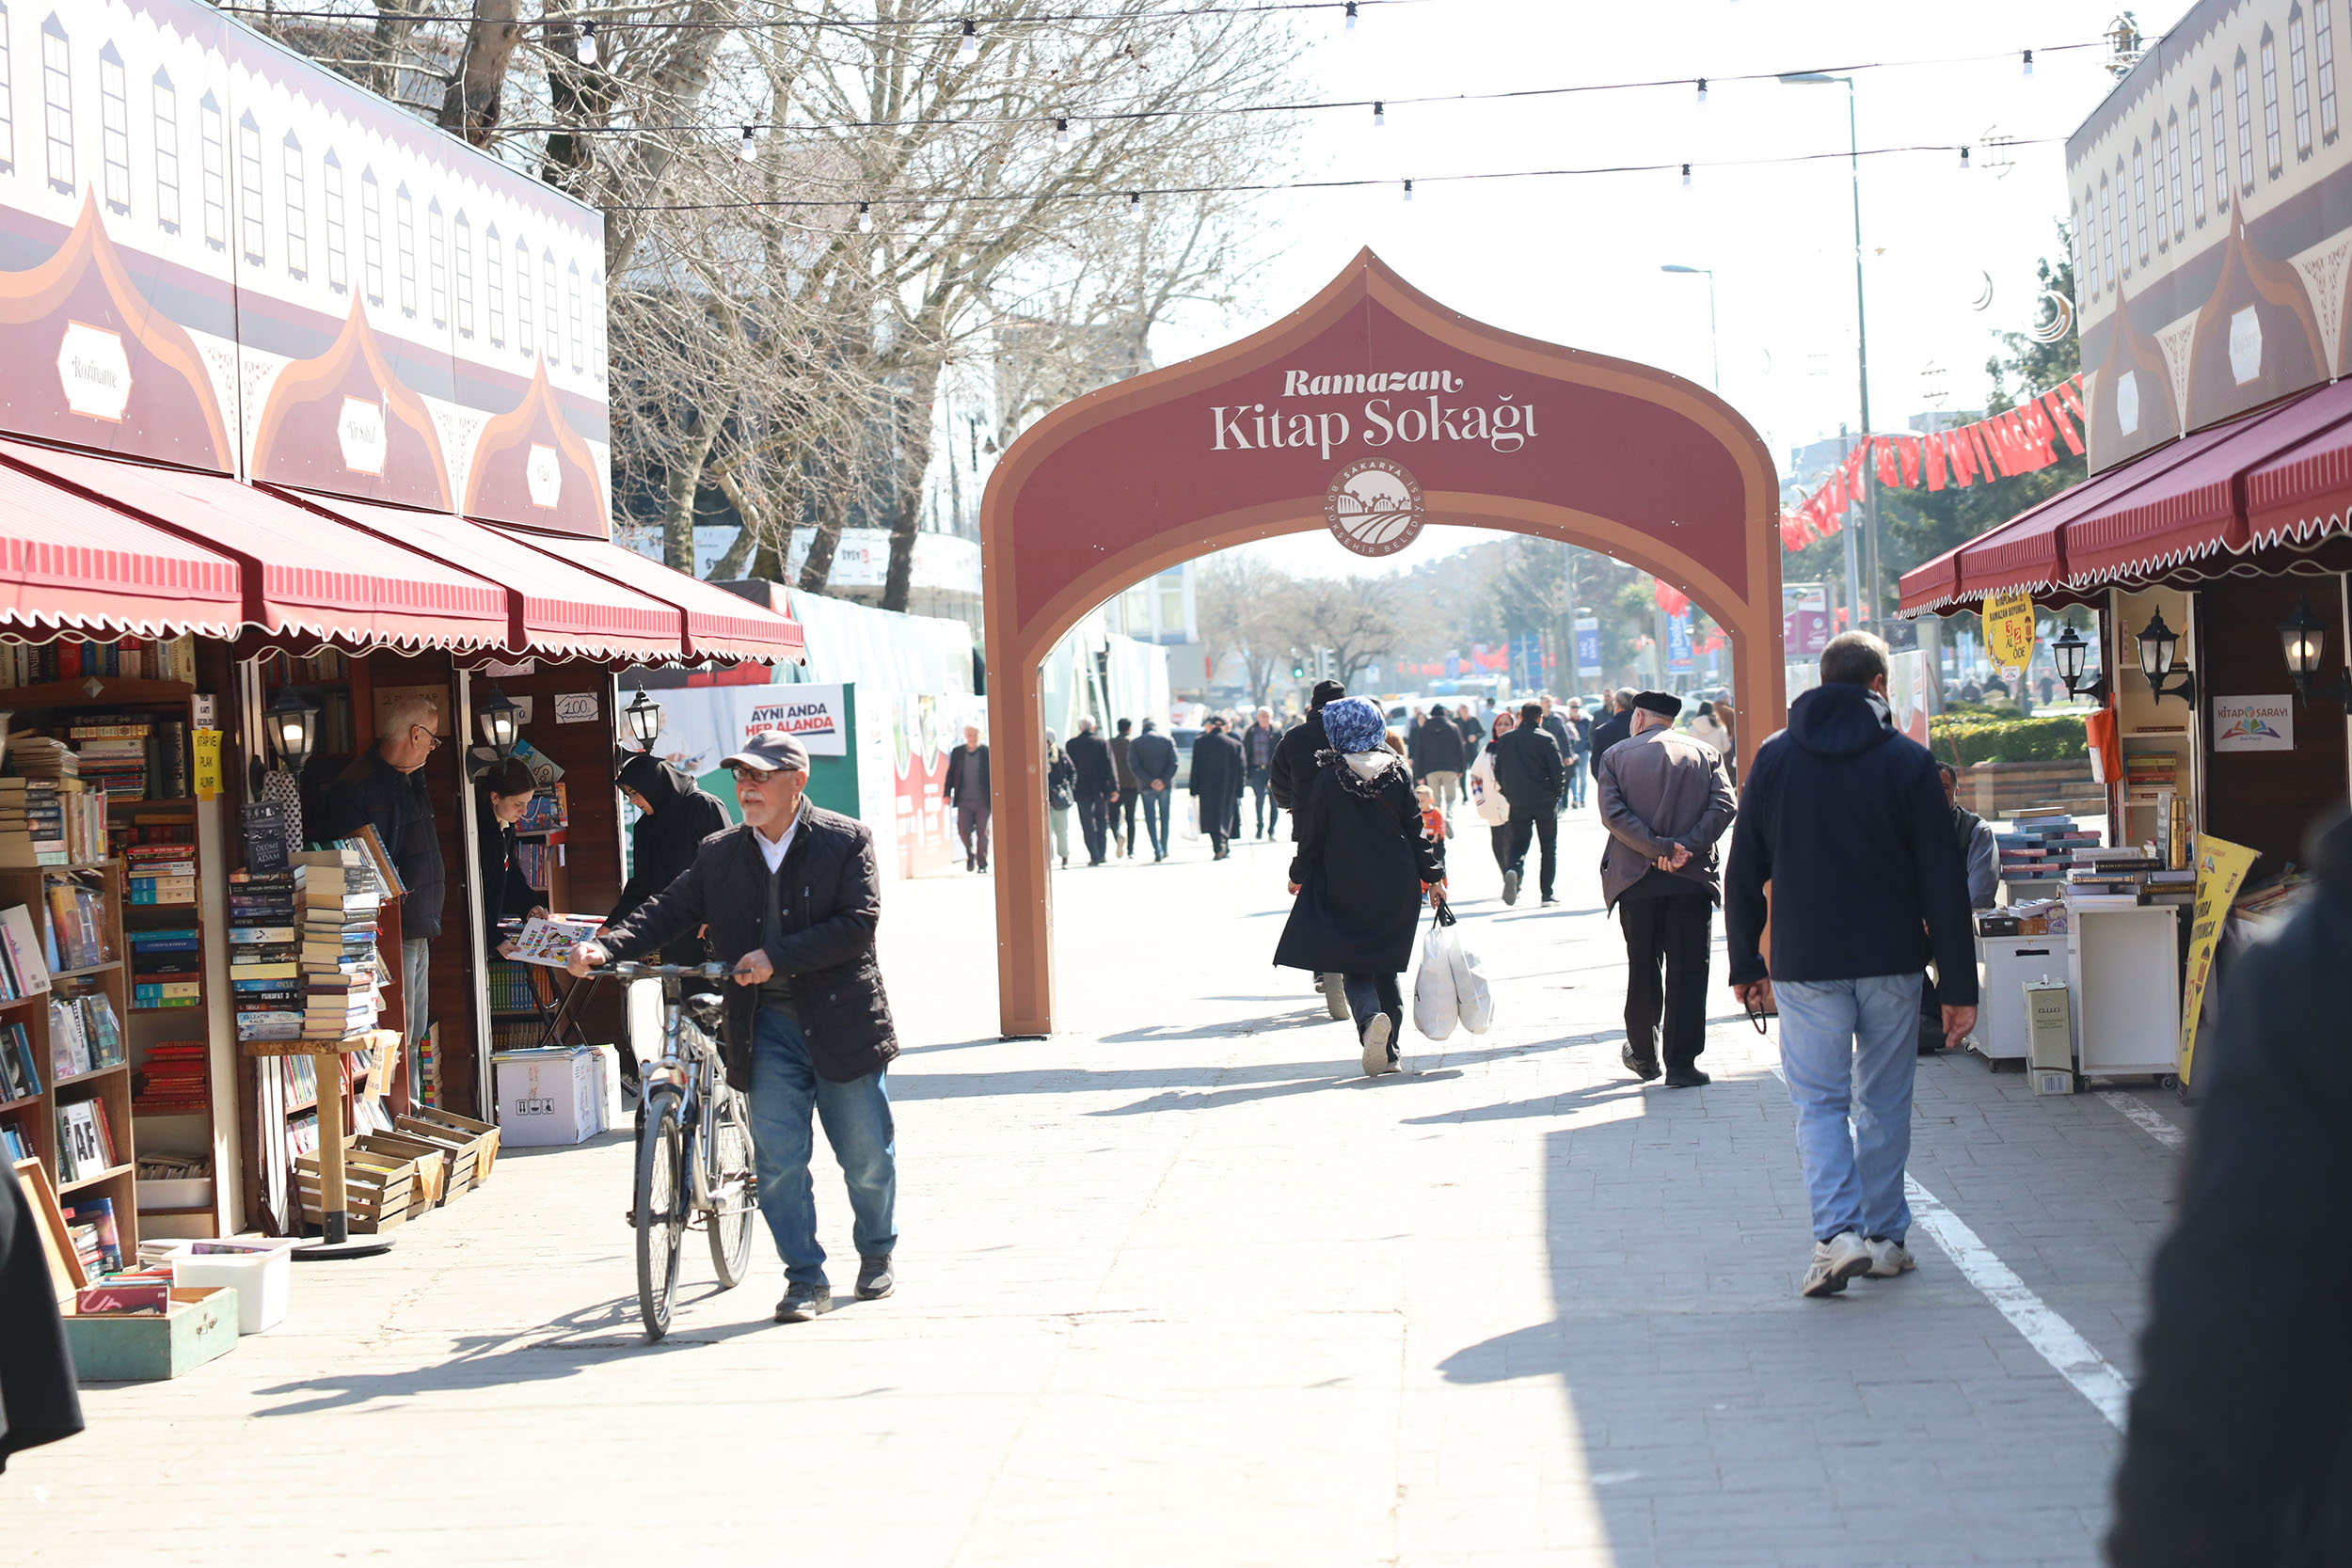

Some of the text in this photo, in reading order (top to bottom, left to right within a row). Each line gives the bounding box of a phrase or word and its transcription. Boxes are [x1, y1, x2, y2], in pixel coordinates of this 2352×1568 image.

[72, 355, 118, 388] Rozinante
[1281, 369, 1464, 398] Ramazan
[1209, 393, 1539, 460] Kitap Sokağı
[1343, 462, 1401, 479] SAKARYA
[1384, 481, 1422, 553] BELEDİYESİ
[1989, 603, 2026, 622] RAMAZAN BOYUNCA
[2006, 621, 2012, 636] 3
[2006, 637, 2013, 648] AL
[752, 703, 827, 722] AYNI ANDA
[2217, 706, 2288, 719] KİTAP SARAYI
[776, 716, 834, 733] ALANDA
